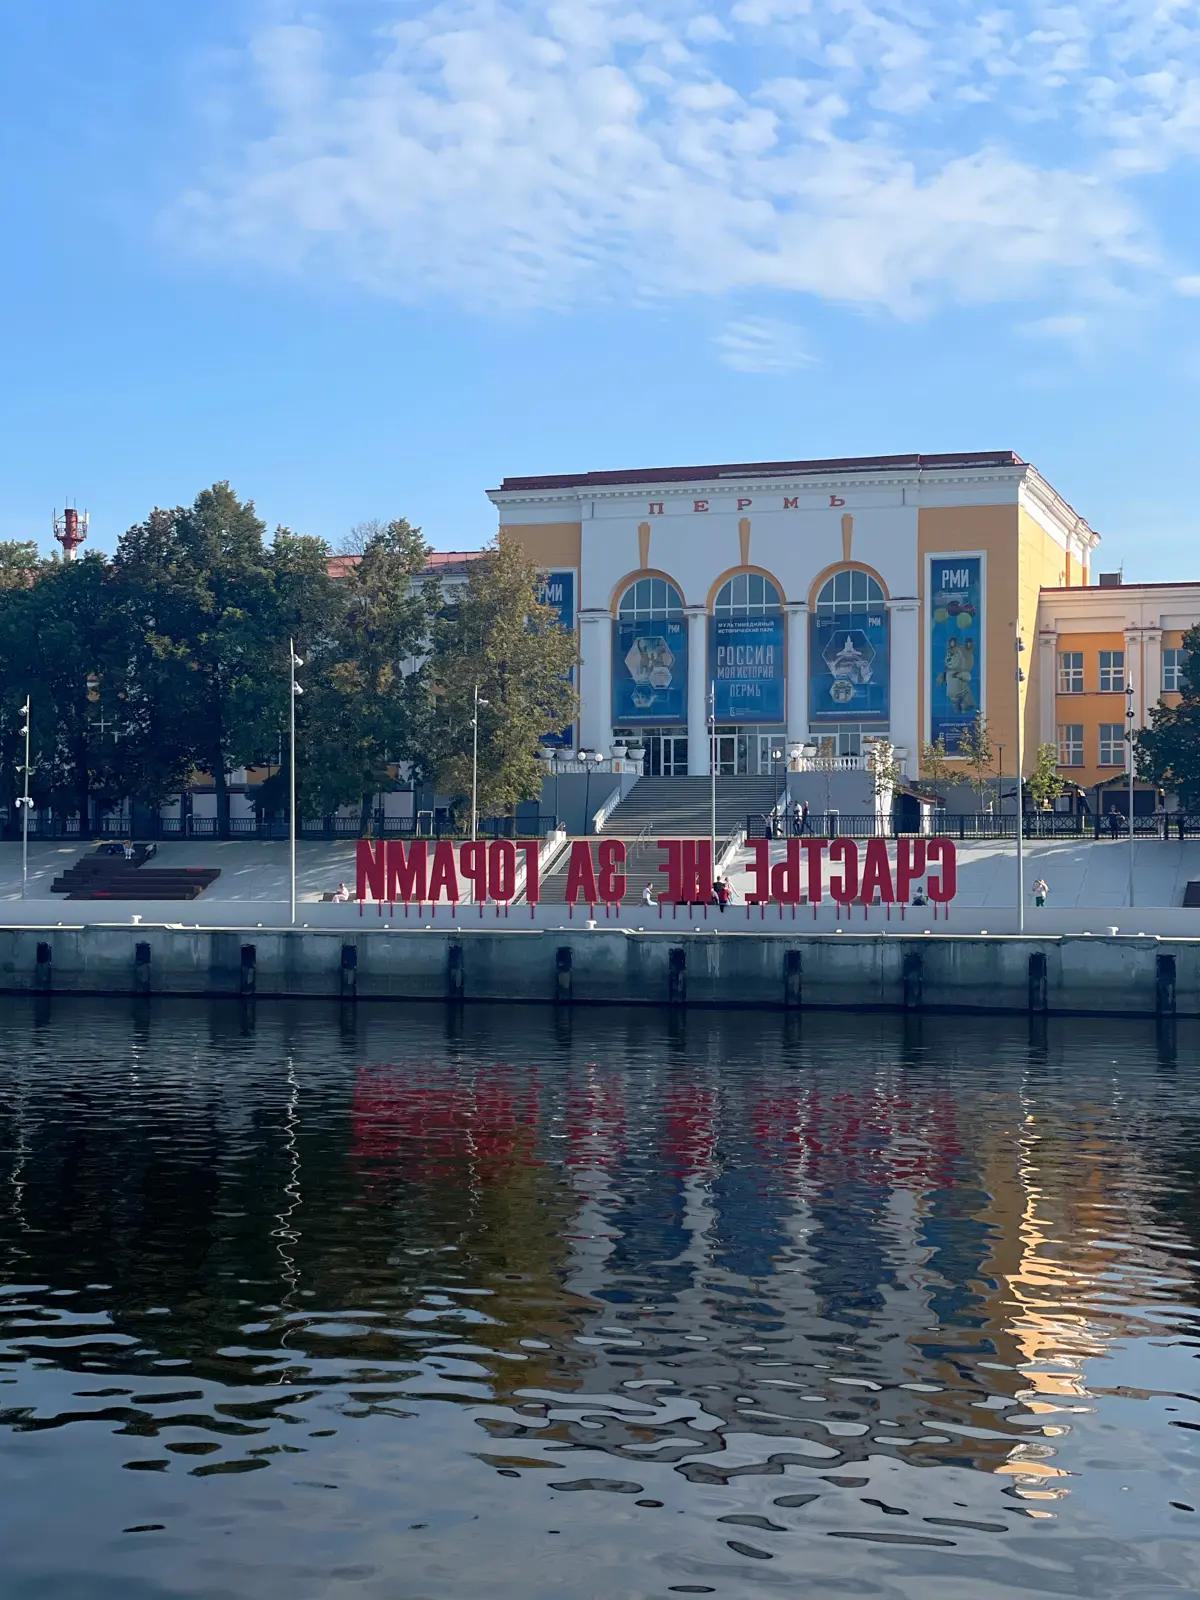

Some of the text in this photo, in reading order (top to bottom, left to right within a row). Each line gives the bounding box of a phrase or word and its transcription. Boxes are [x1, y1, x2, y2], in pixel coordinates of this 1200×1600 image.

[648, 495, 846, 515] ПЕРМЬ
[941, 569, 970, 588] РМИ
[867, 617, 881, 627] РМИ
[717, 645, 774, 665] РОССИЯ
[717, 665, 774, 679] МОЯ ИСТОРИЯ
[730, 683, 761, 697] ПЕРМЬ
